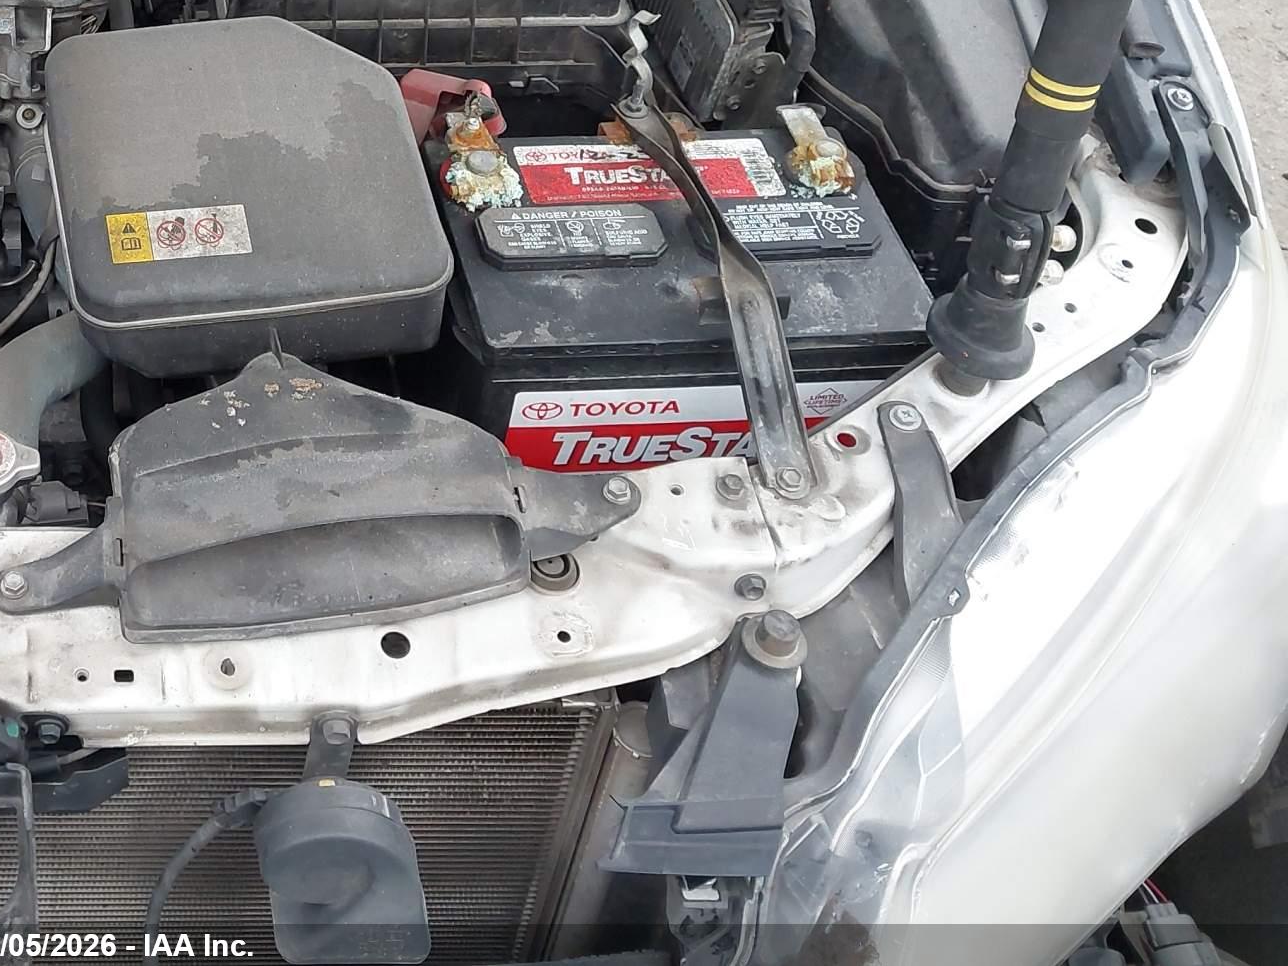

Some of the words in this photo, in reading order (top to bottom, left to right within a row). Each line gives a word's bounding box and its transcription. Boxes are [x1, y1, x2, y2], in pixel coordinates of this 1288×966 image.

[523, 211, 568, 220] DANGER
[579, 209, 622, 218] POISON
[570, 400, 680, 417] TOYOTA
[552, 426, 755, 466] TRUESTA
